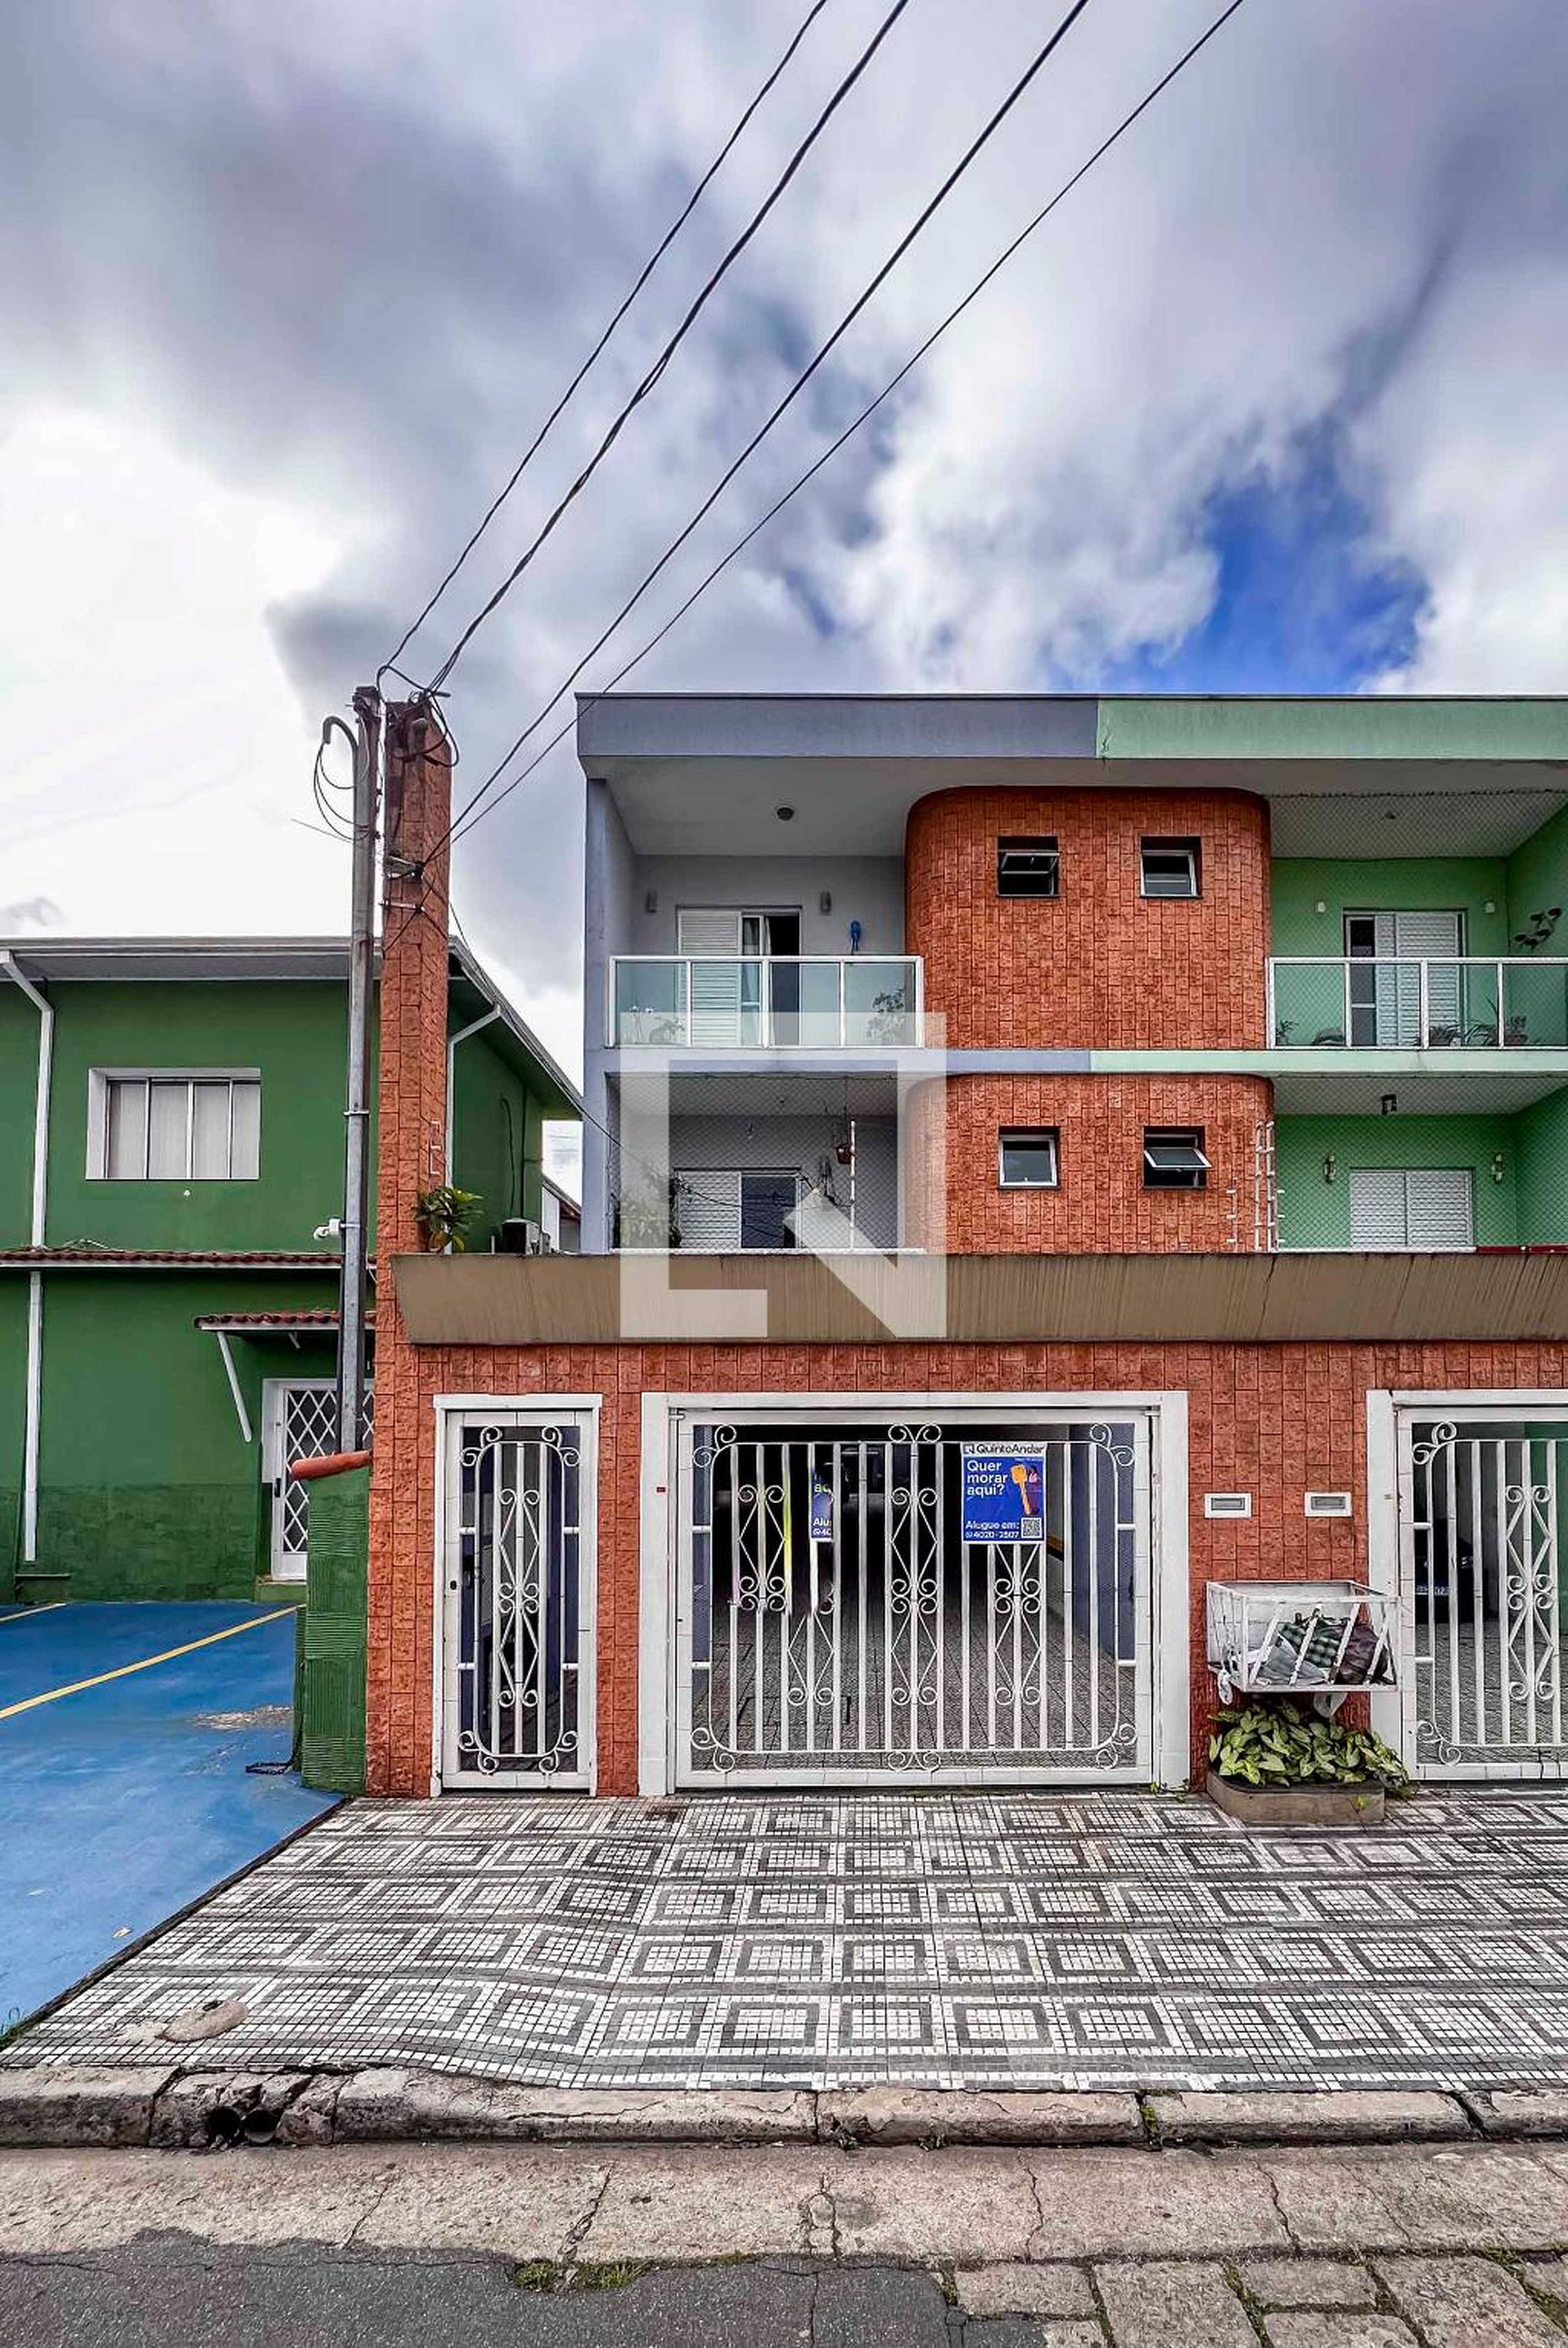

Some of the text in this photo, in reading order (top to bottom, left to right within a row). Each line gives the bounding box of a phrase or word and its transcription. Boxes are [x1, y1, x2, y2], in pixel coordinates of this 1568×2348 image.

[977, 1444, 1044, 1454] QuintoAndar
[967, 1460, 1002, 1471] Quer
[967, 1474, 1008, 1483] morar
[967, 1484, 1005, 1498] aqui?
[965, 1520, 1000, 1530] Alugue
